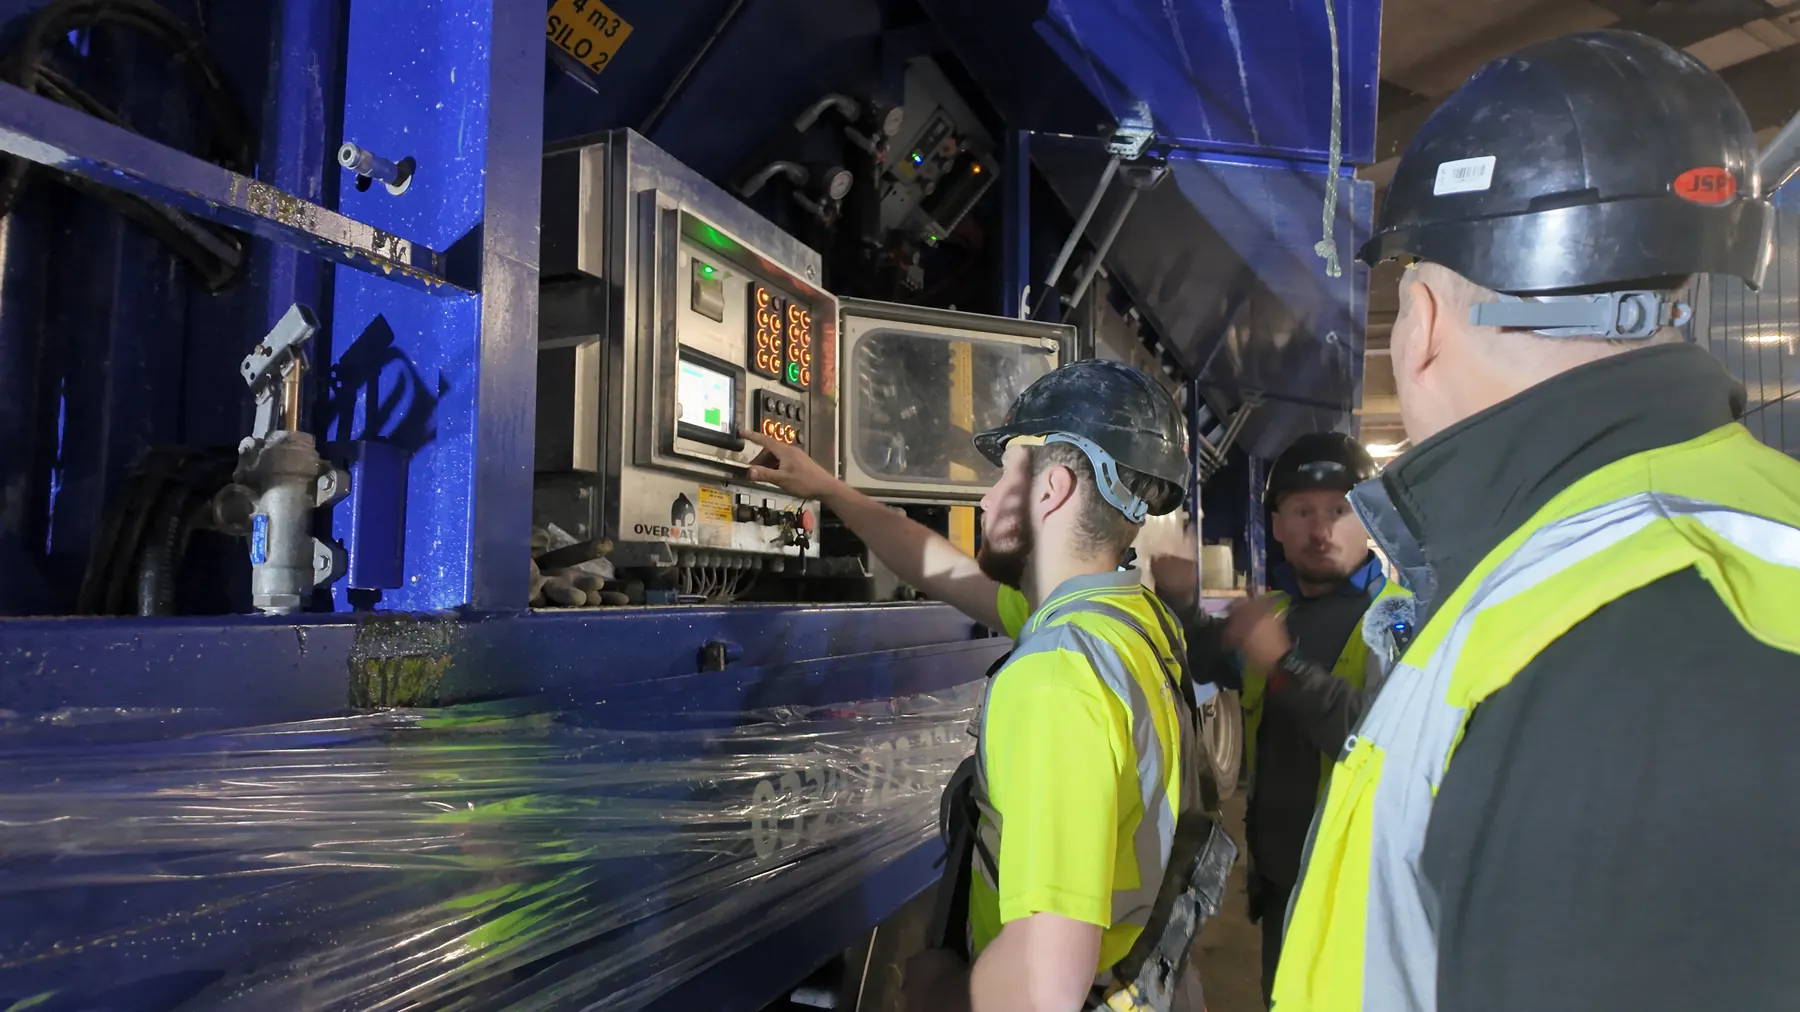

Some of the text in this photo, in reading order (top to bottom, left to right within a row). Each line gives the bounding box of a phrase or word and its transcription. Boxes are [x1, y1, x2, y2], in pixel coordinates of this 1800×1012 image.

[572, 0, 621, 37] 4 m3
[546, 15, 608, 72] SILO 2
[1685, 174, 1727, 192] JSP
